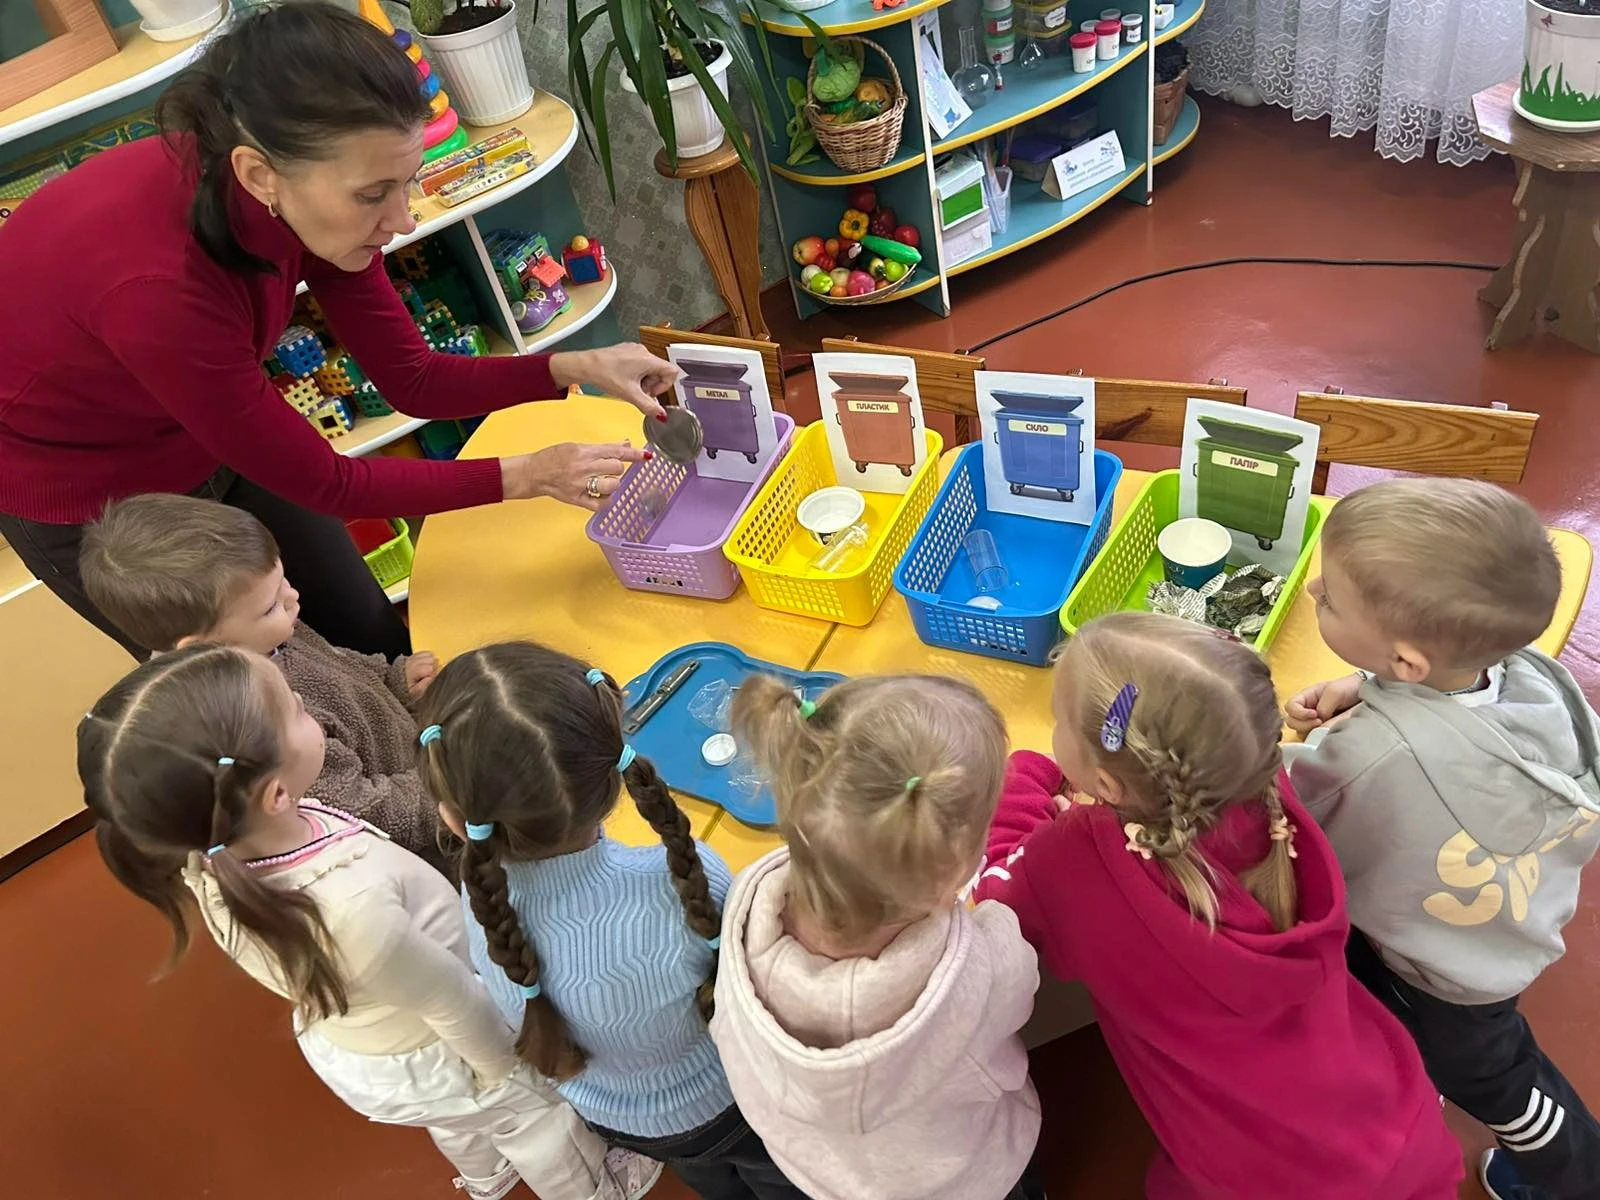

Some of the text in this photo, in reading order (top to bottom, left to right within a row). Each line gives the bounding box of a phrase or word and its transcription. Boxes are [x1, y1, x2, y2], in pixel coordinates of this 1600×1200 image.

[705, 390, 729, 398] МЕТАЛ
[856, 403, 890, 411] ПЛАСТИК
[1025, 423, 1049, 432] СКЛО
[1230, 457, 1259, 470] ПАПІР
